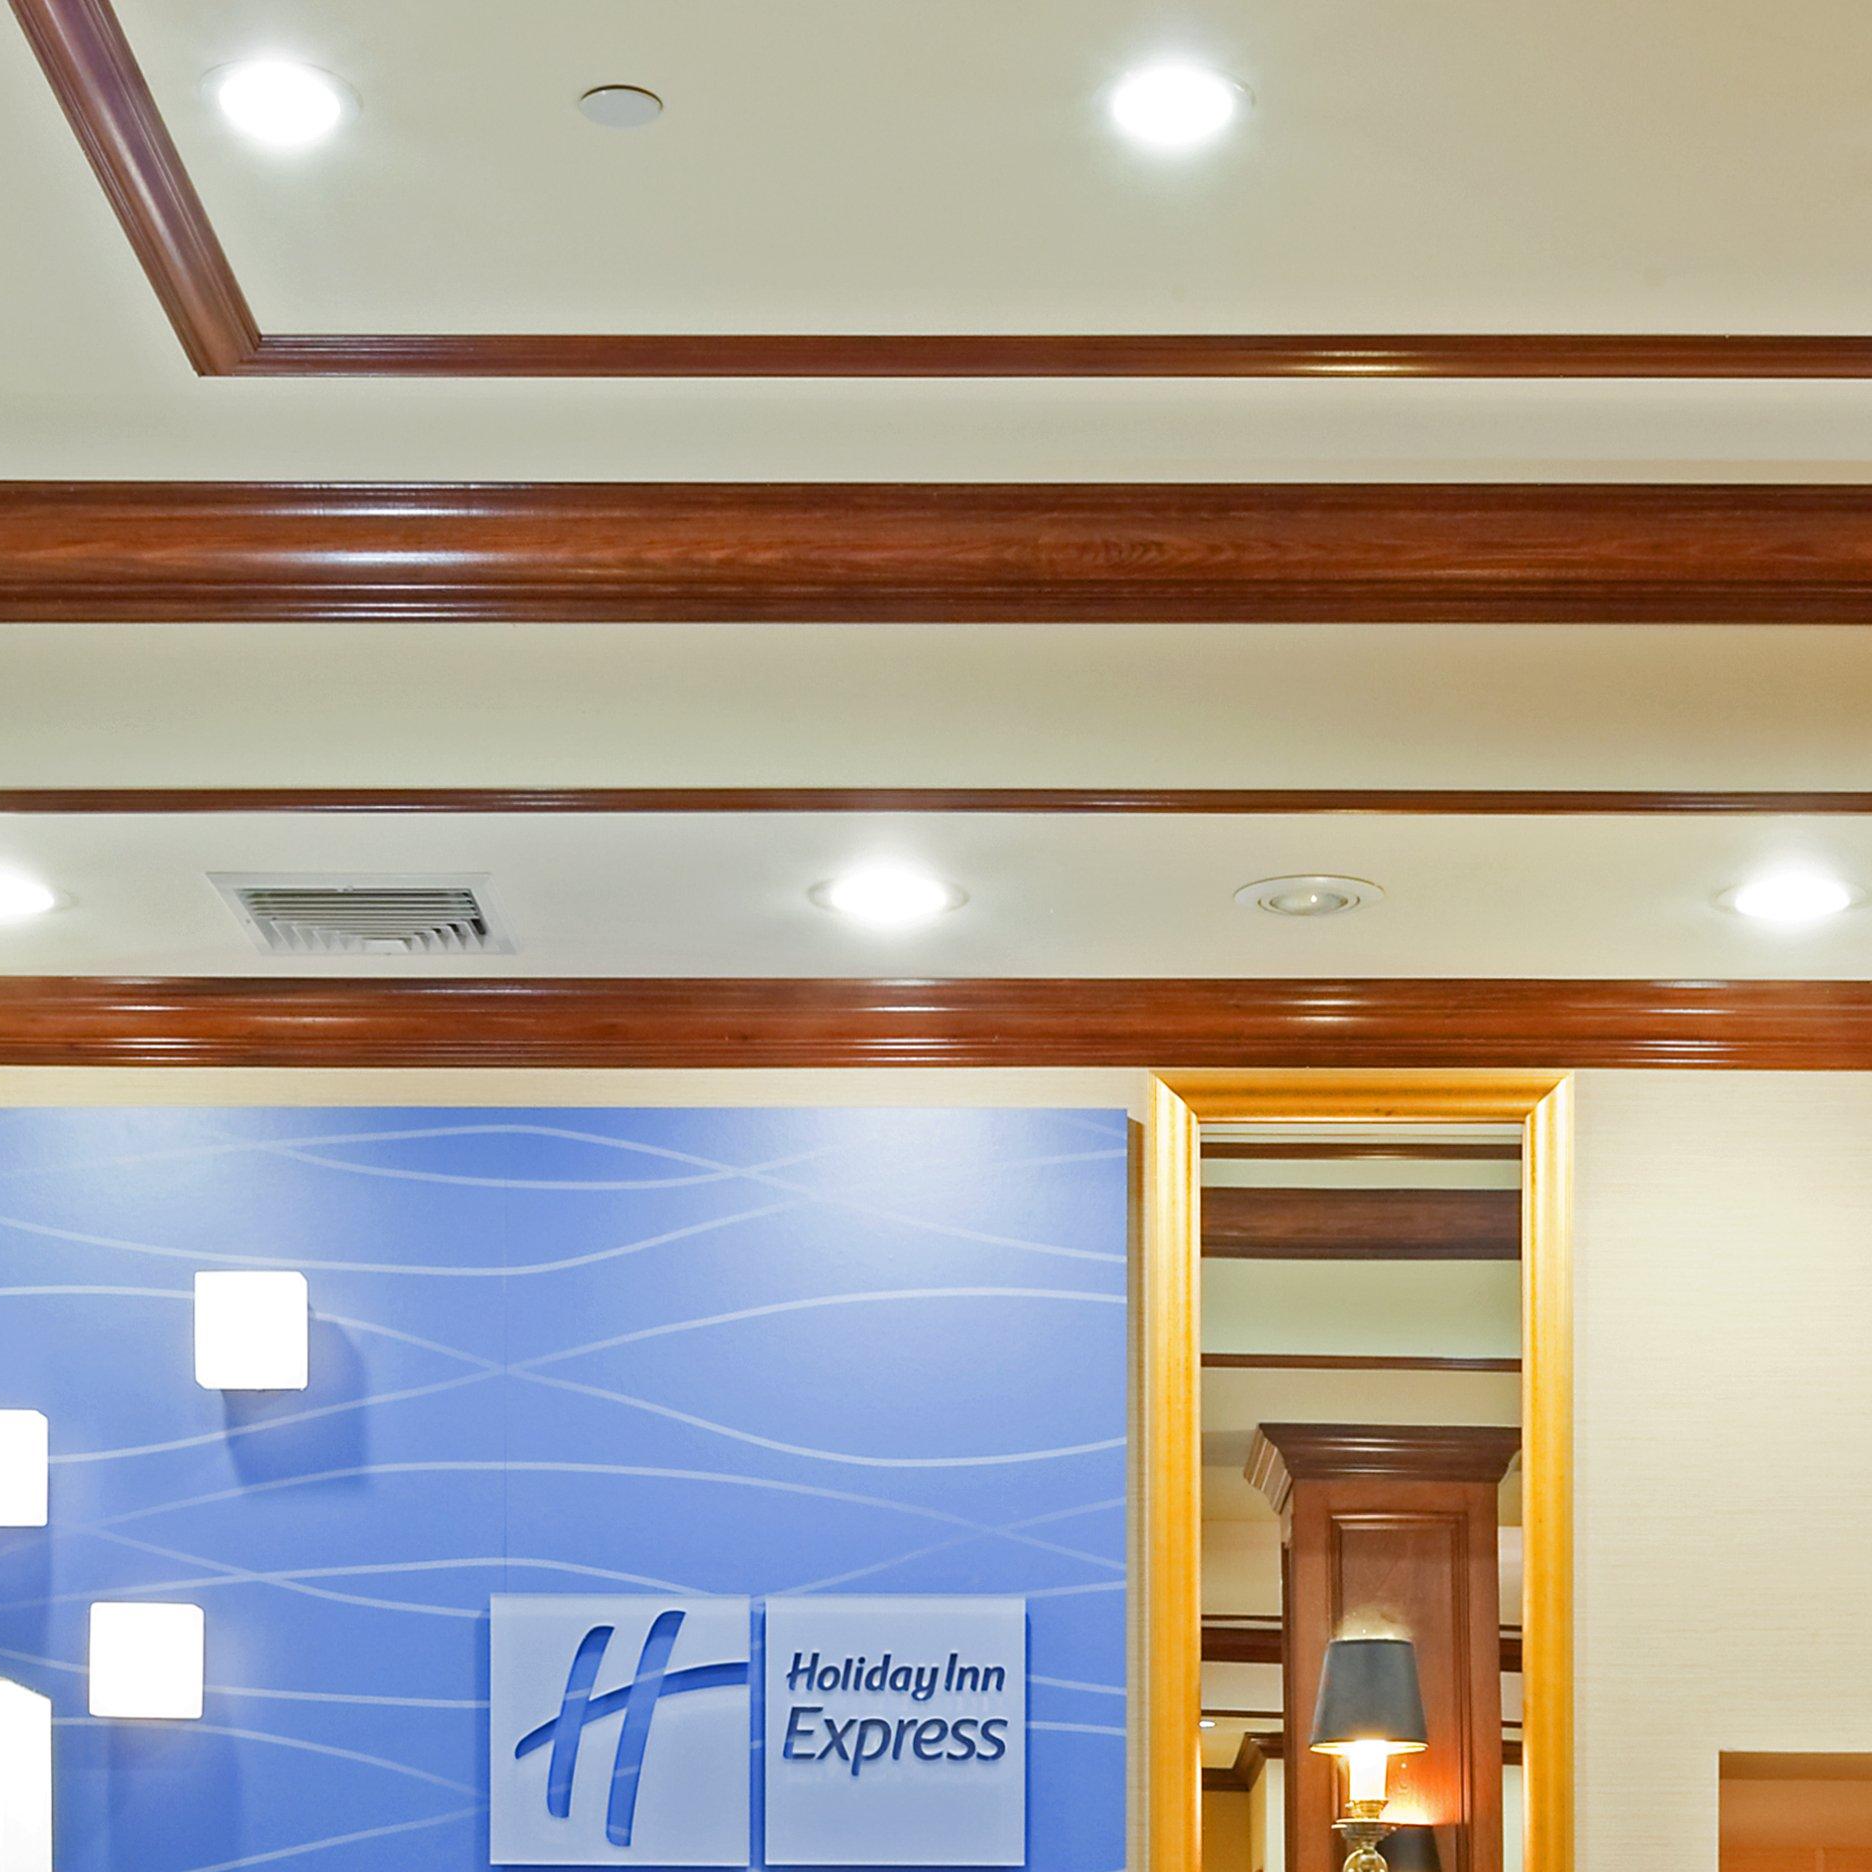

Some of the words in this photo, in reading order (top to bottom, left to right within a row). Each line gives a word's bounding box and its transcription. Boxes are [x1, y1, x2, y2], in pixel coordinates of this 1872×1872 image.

[785, 1652, 938, 1701] Holiday
[944, 1653, 1006, 1693] Inn
[783, 1705, 1009, 1777] Express
